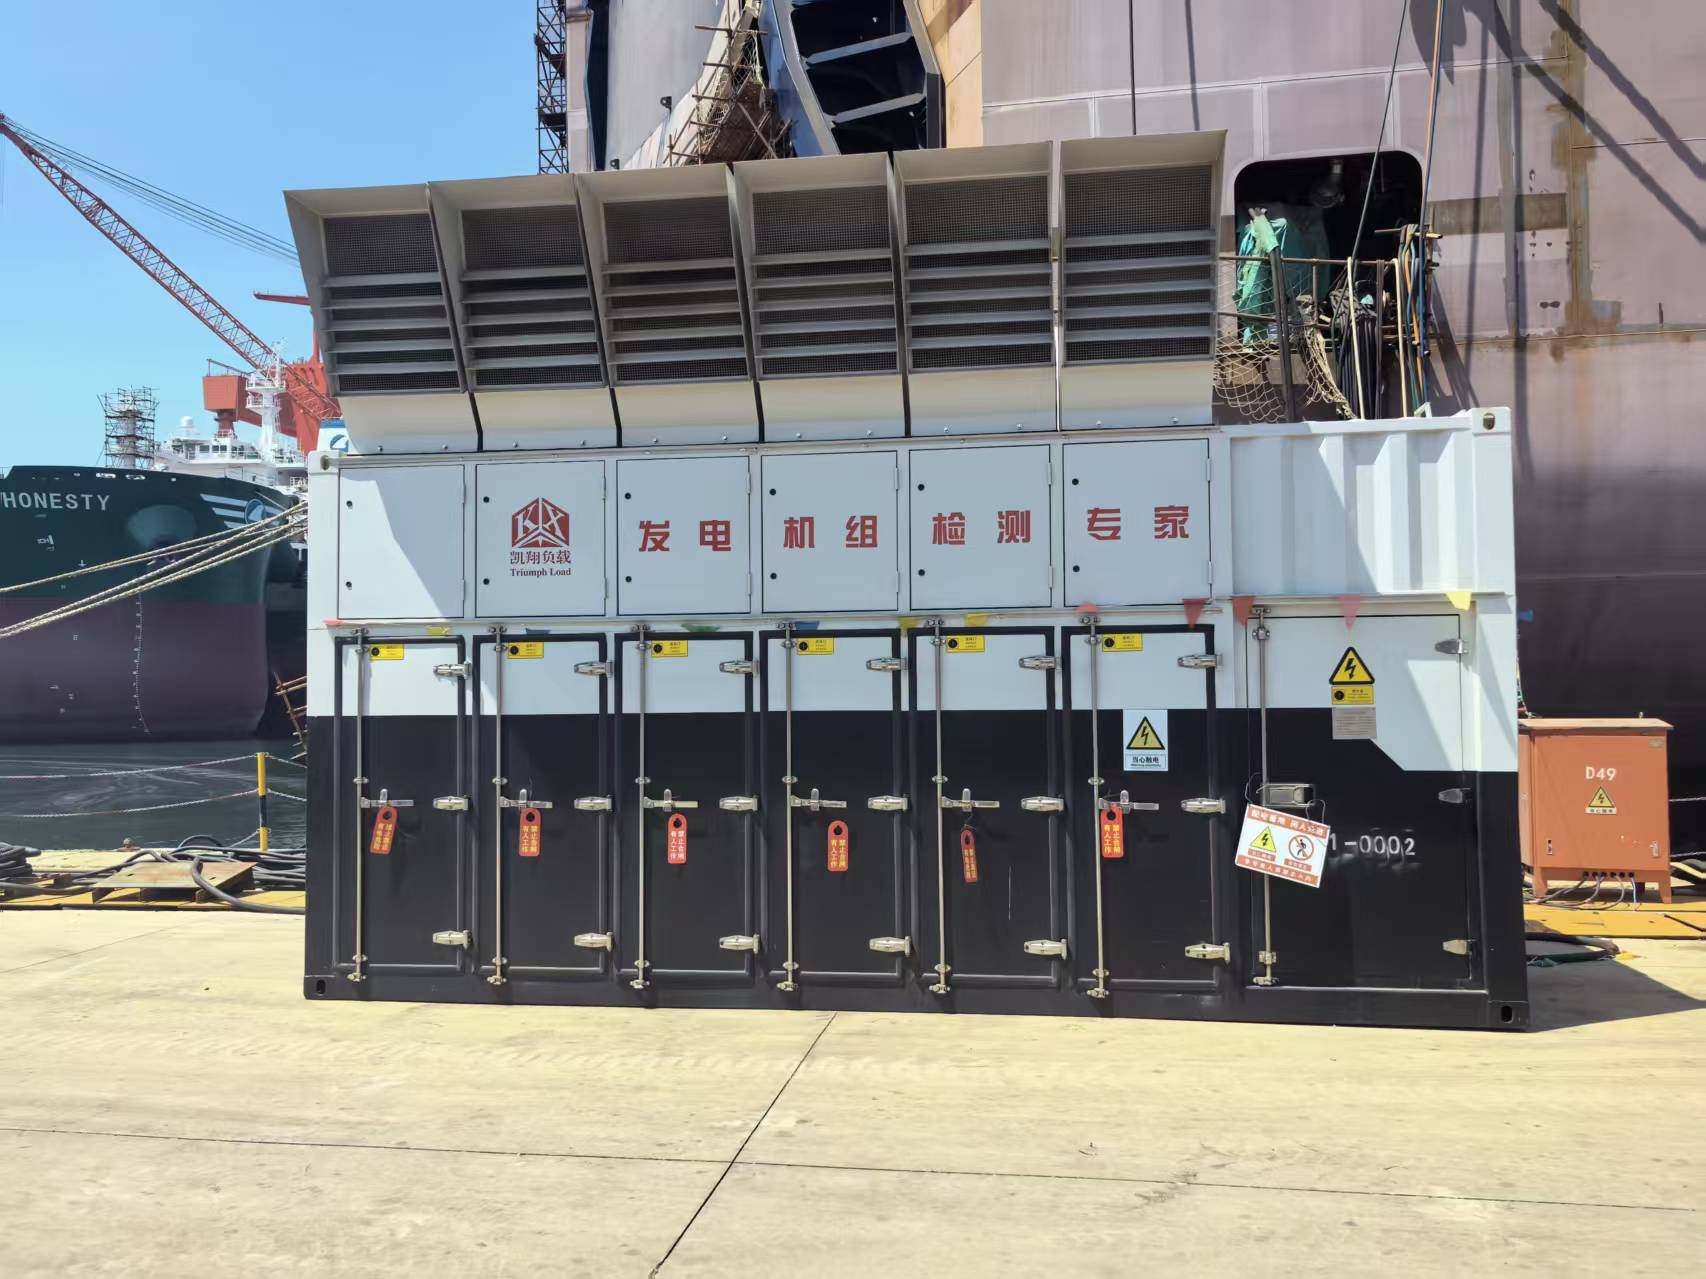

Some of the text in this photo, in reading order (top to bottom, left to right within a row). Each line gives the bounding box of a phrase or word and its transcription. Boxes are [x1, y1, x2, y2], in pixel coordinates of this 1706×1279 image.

[1, 491, 110, 511] HONESTY
[510, 550, 571, 564] 凯翔负载
[510, 567, 571, 578] Triumph Load
[1585, 765, 1617, 781] D49
